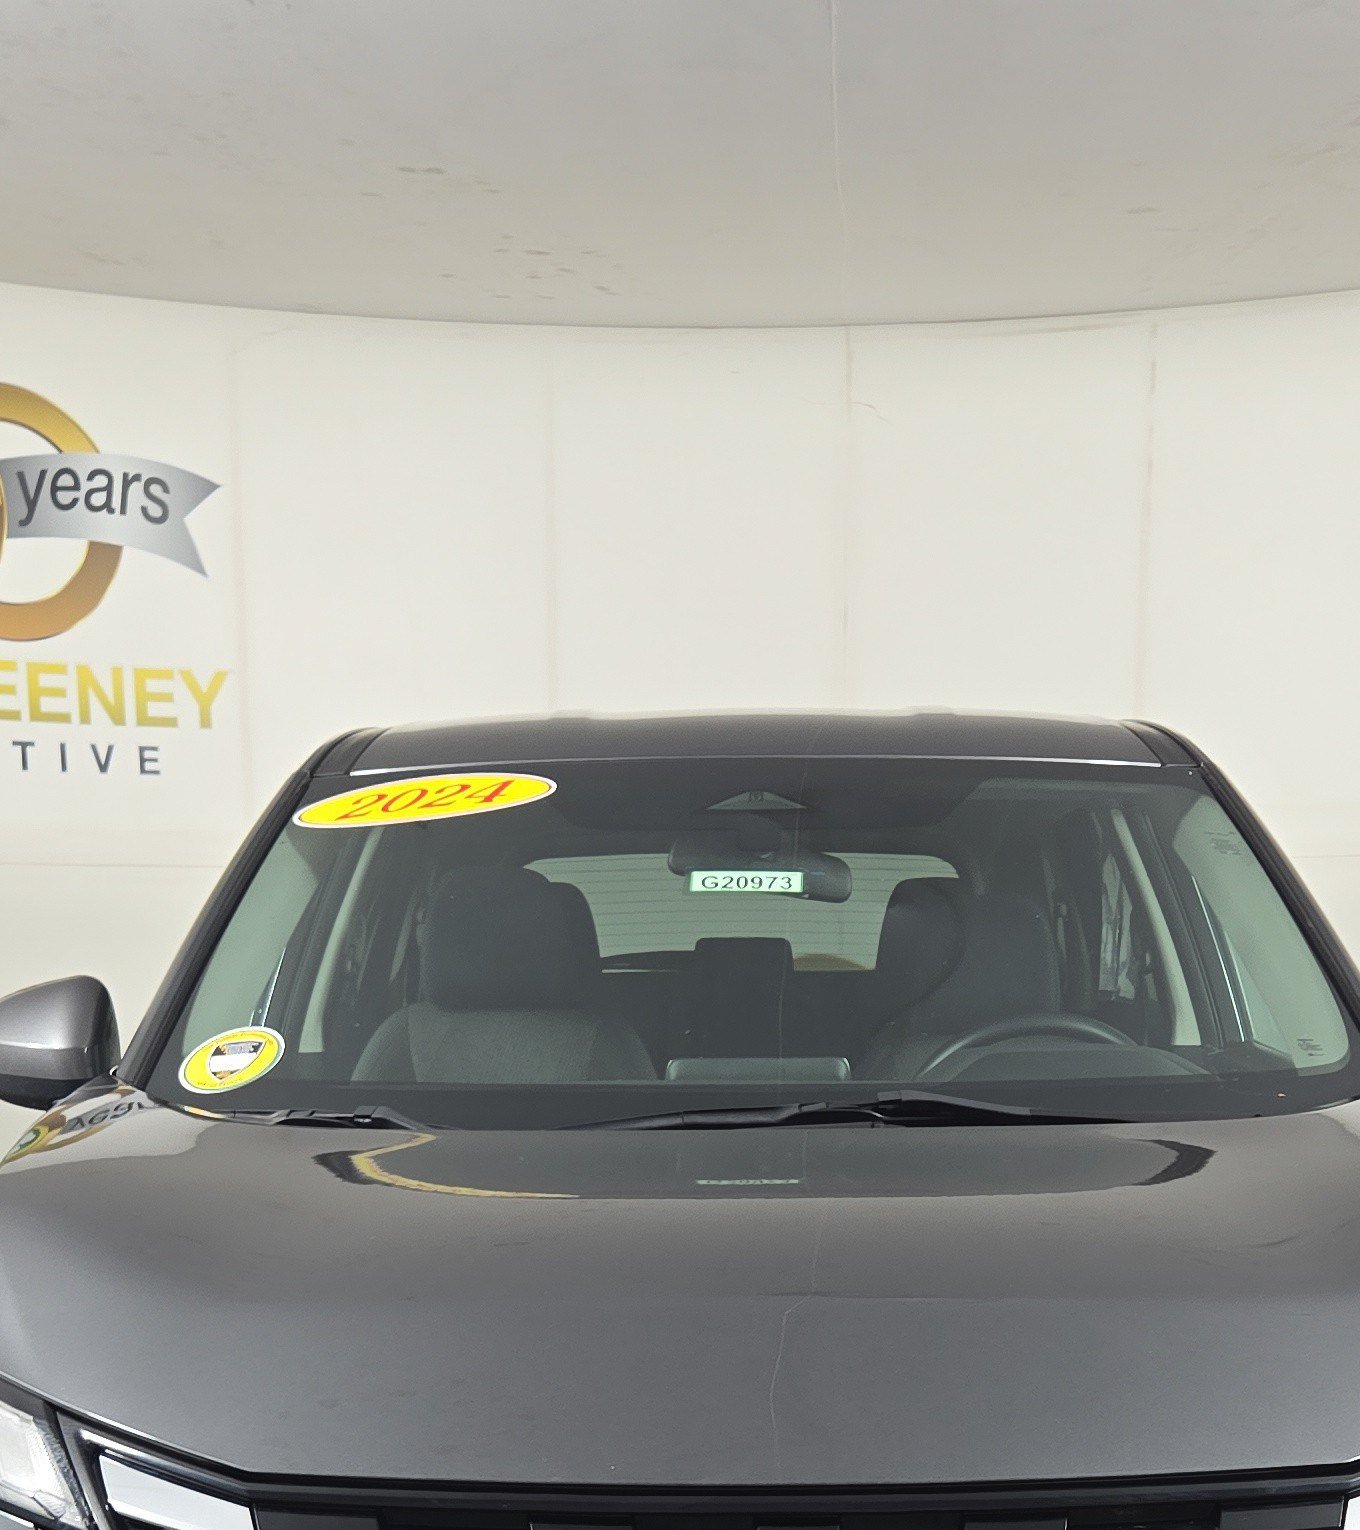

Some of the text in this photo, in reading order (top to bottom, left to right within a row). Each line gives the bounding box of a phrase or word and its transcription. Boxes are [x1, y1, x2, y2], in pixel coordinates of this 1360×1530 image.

[16, 464, 171, 528] years
[334, 778, 515, 821] 2024
[701, 875, 792, 890] G20973
